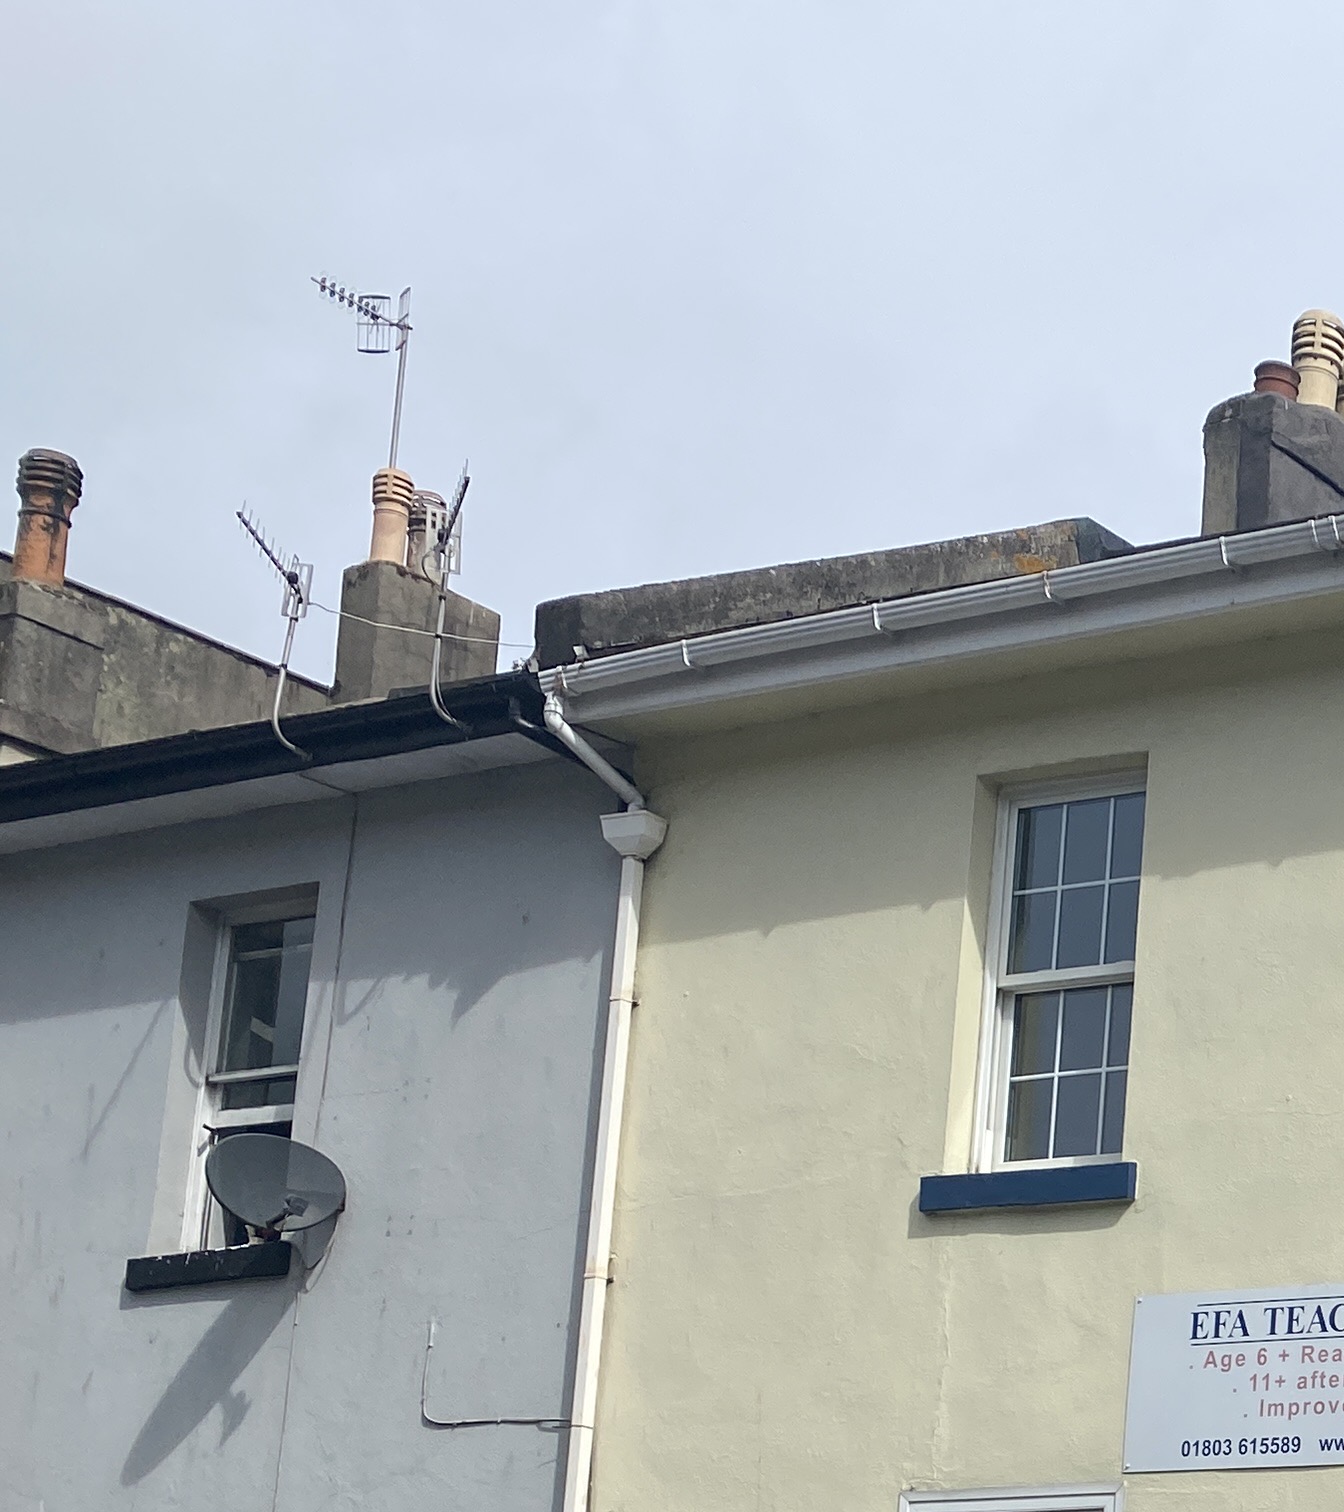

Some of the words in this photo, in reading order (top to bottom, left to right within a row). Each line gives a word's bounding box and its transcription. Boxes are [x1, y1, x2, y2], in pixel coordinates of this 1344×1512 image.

[1190, 1309, 1250, 1340] EFA
[1203, 1350, 1246, 1373] Age
[1256, 1348, 1268, 1366] 6
[1278, 1350, 1289, 1362] +
[1250, 1373, 1286, 1392] 11+
[1181, 1439, 1232, 1458] 01803
[1238, 1436, 1301, 1456] 615589
